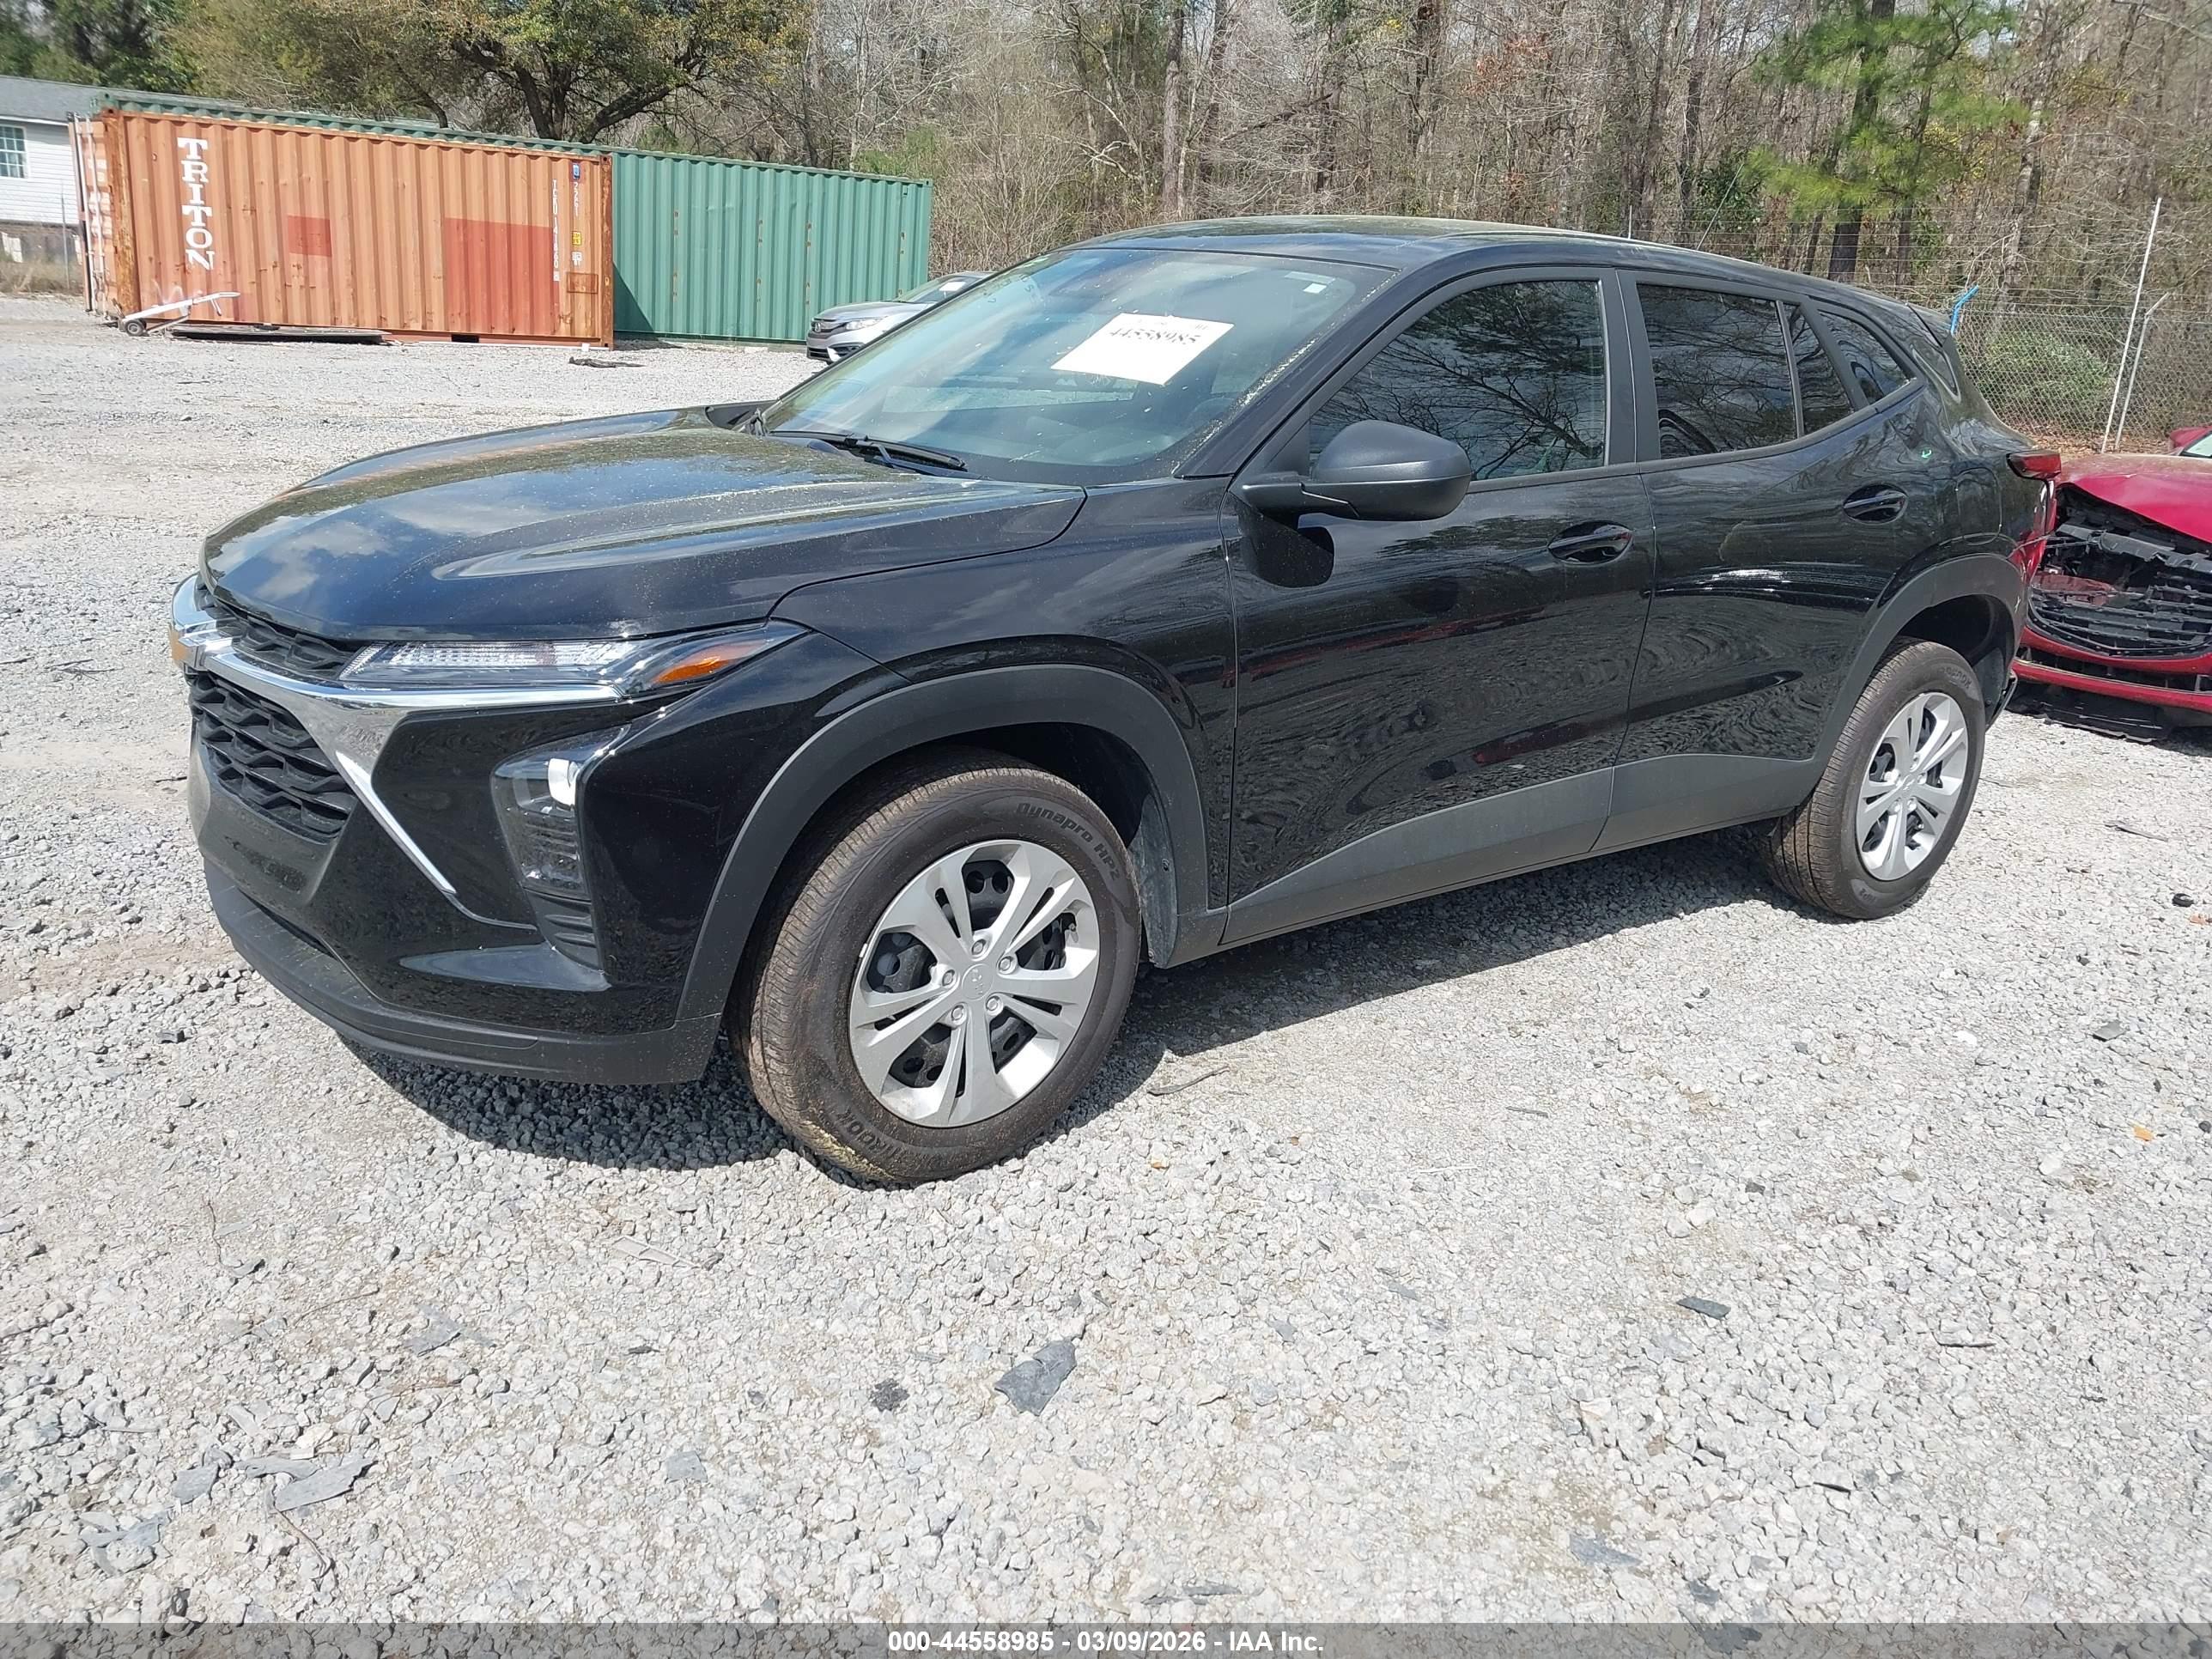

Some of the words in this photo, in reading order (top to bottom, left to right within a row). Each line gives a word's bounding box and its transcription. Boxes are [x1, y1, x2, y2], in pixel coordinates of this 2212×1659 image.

[176, 137, 216, 271] TRITON
[1109, 327, 1201, 345] 44558985
[1016, 803, 1093, 843] Dynapro
[1094, 843, 1120, 881] HP2
